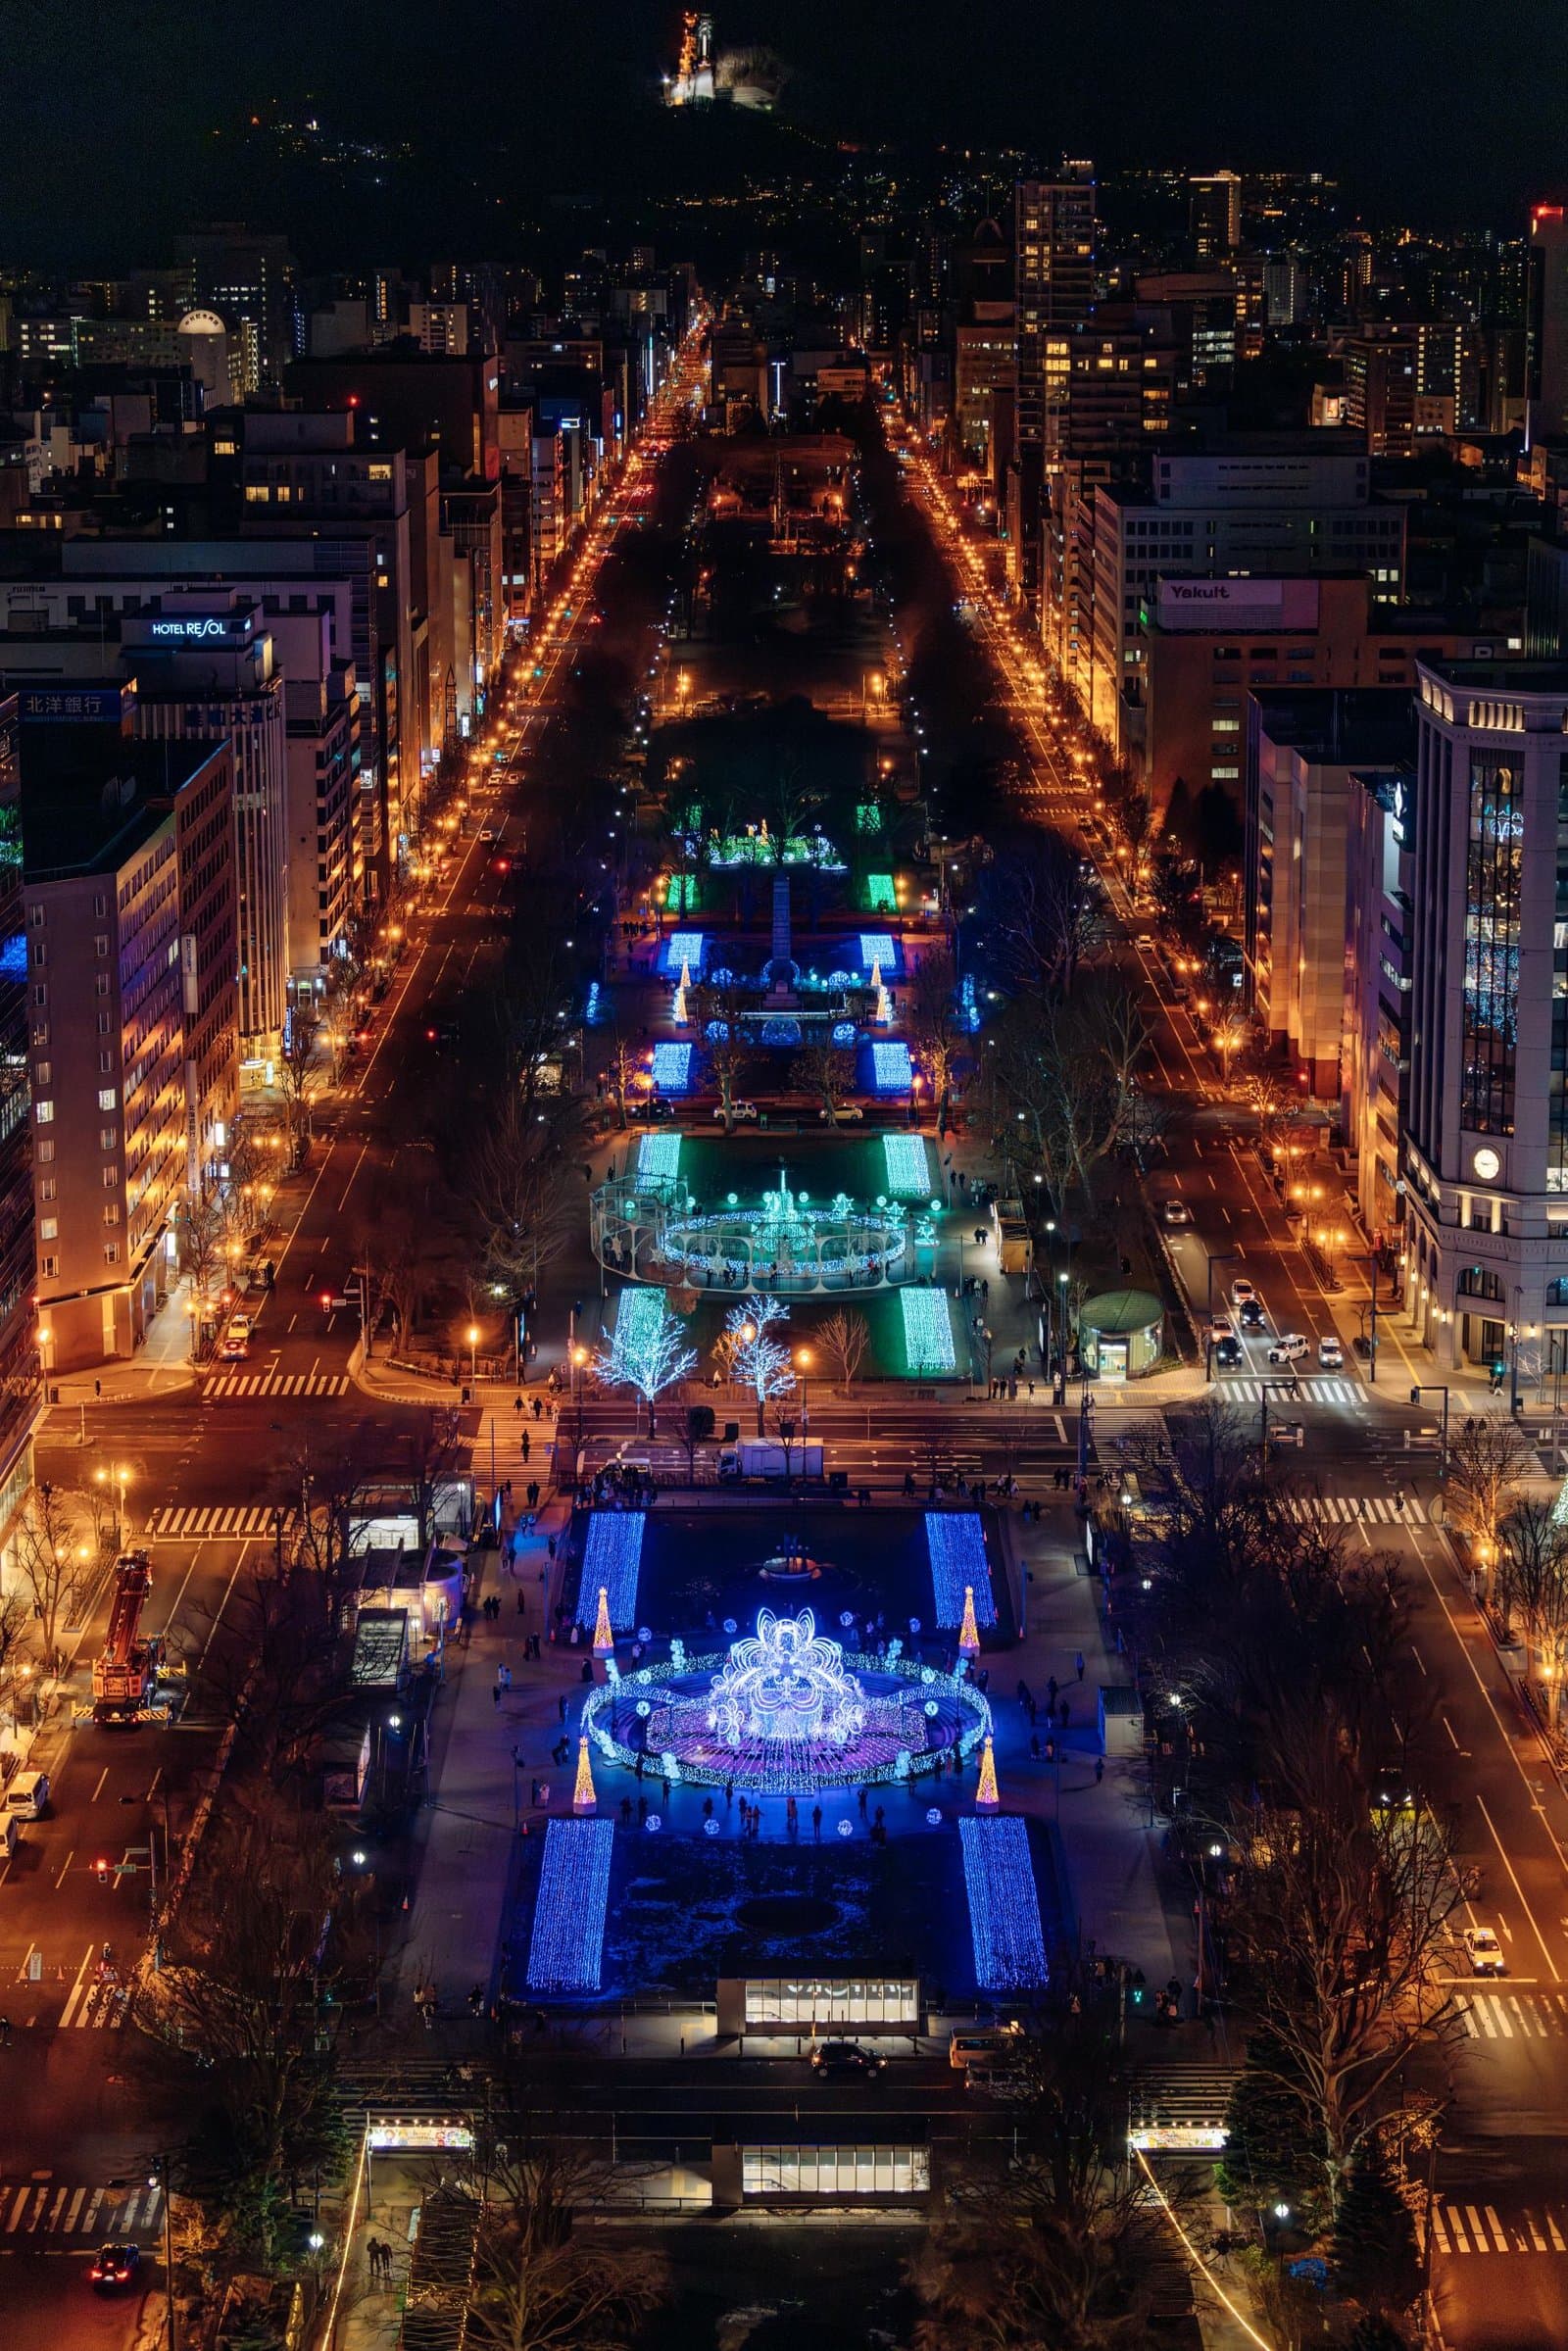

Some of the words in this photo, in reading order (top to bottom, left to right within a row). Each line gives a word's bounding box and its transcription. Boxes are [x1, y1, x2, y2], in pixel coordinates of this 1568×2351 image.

[1170, 585, 1230, 599] Yakult
[152, 623, 185, 635] HOTEL
[186, 618, 226, 638] RESOL
[24, 694, 103, 714] 北洋銀行
